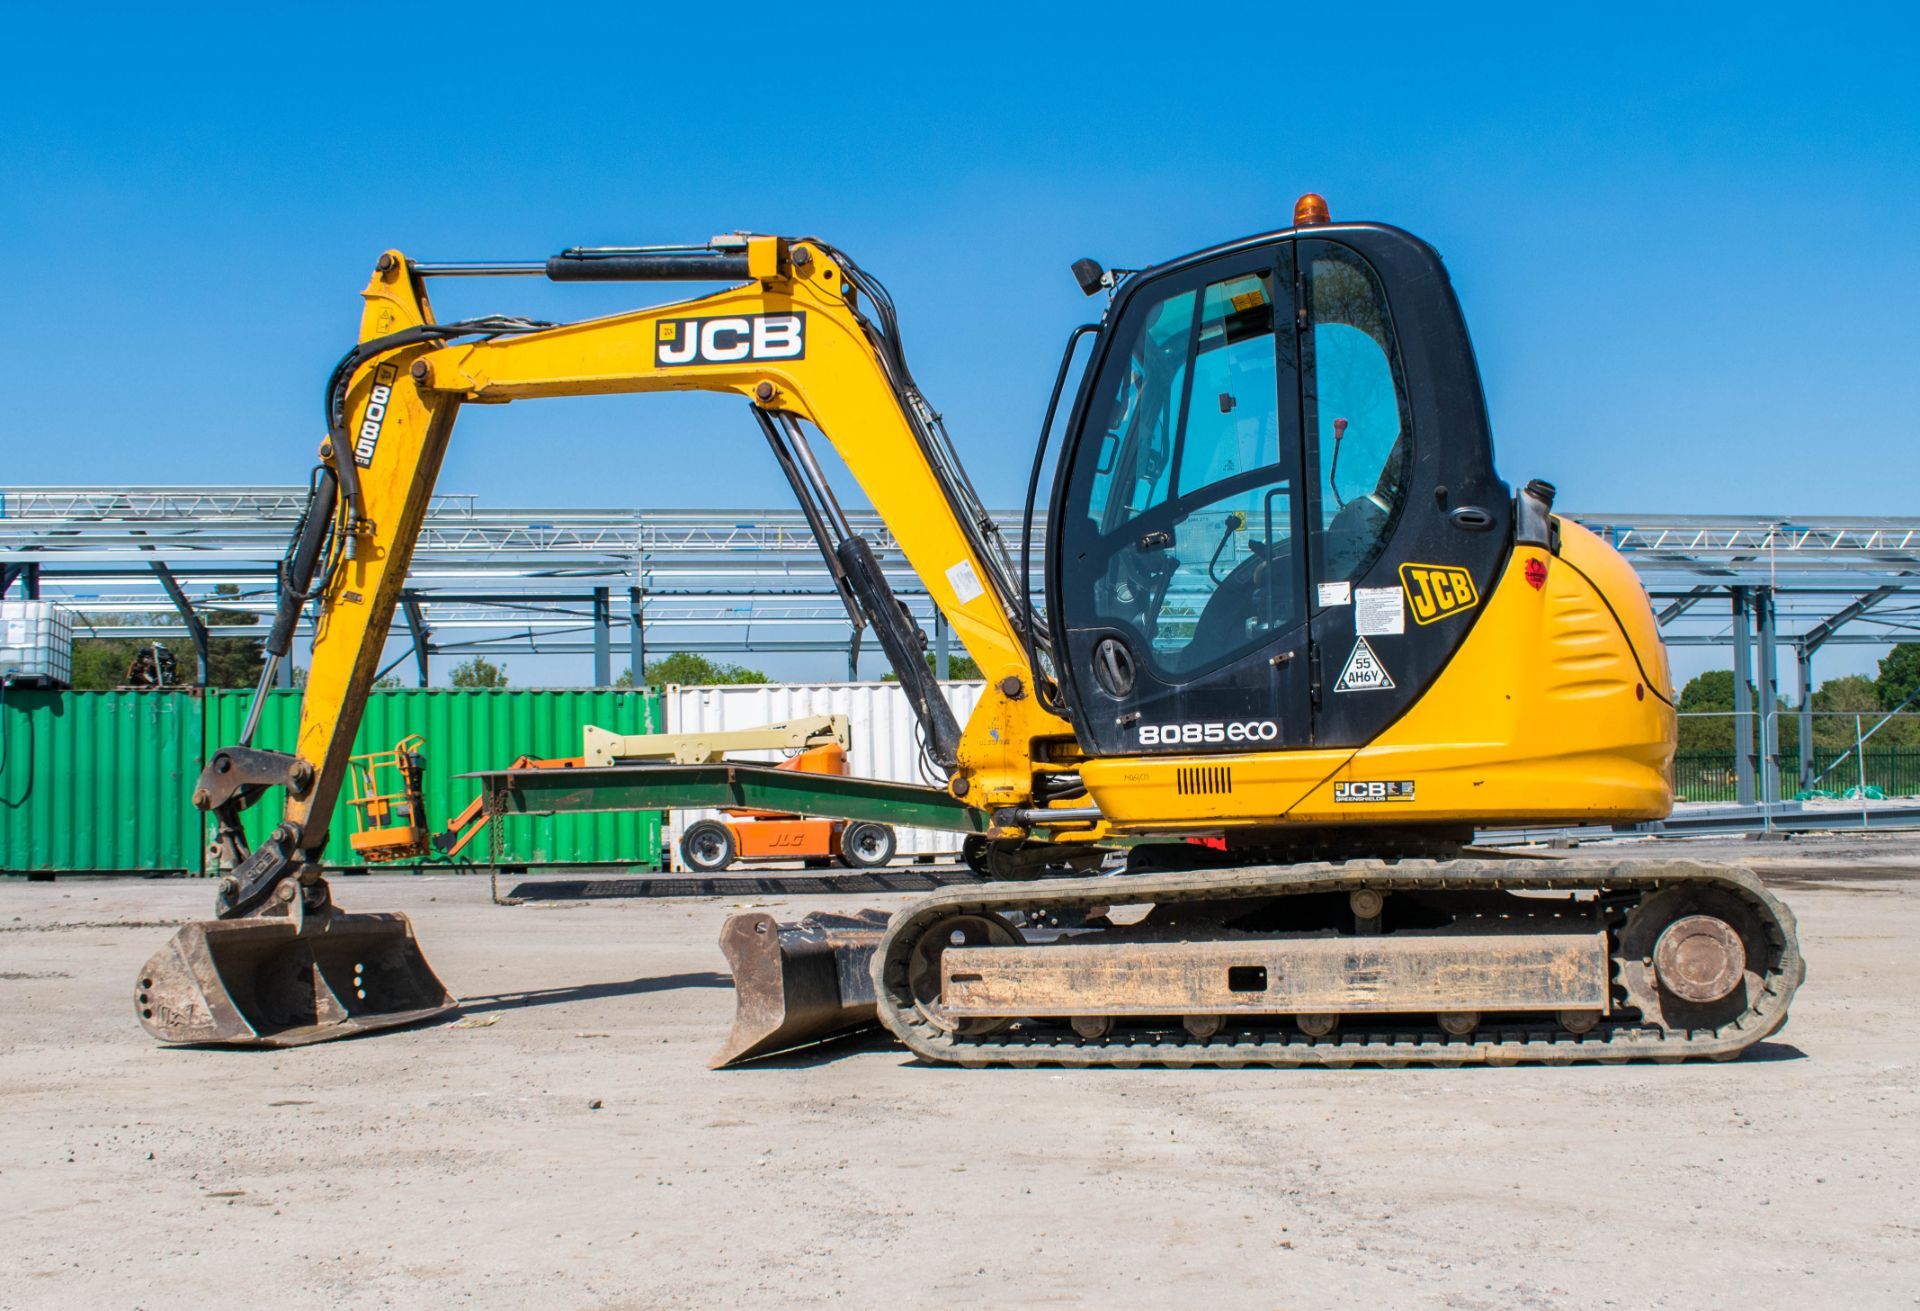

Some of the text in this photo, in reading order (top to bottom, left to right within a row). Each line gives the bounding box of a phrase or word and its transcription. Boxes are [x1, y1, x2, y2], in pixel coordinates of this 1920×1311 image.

[658, 316, 802, 364] JCB
[355, 384, 391, 459] 8085
[1411, 569, 1472, 618] JCB
[1355, 657, 1371, 669] 55
[1348, 670, 1379, 683] AH6Y
[1335, 782, 1386, 797] JCB
[768, 833, 805, 847] JLG
